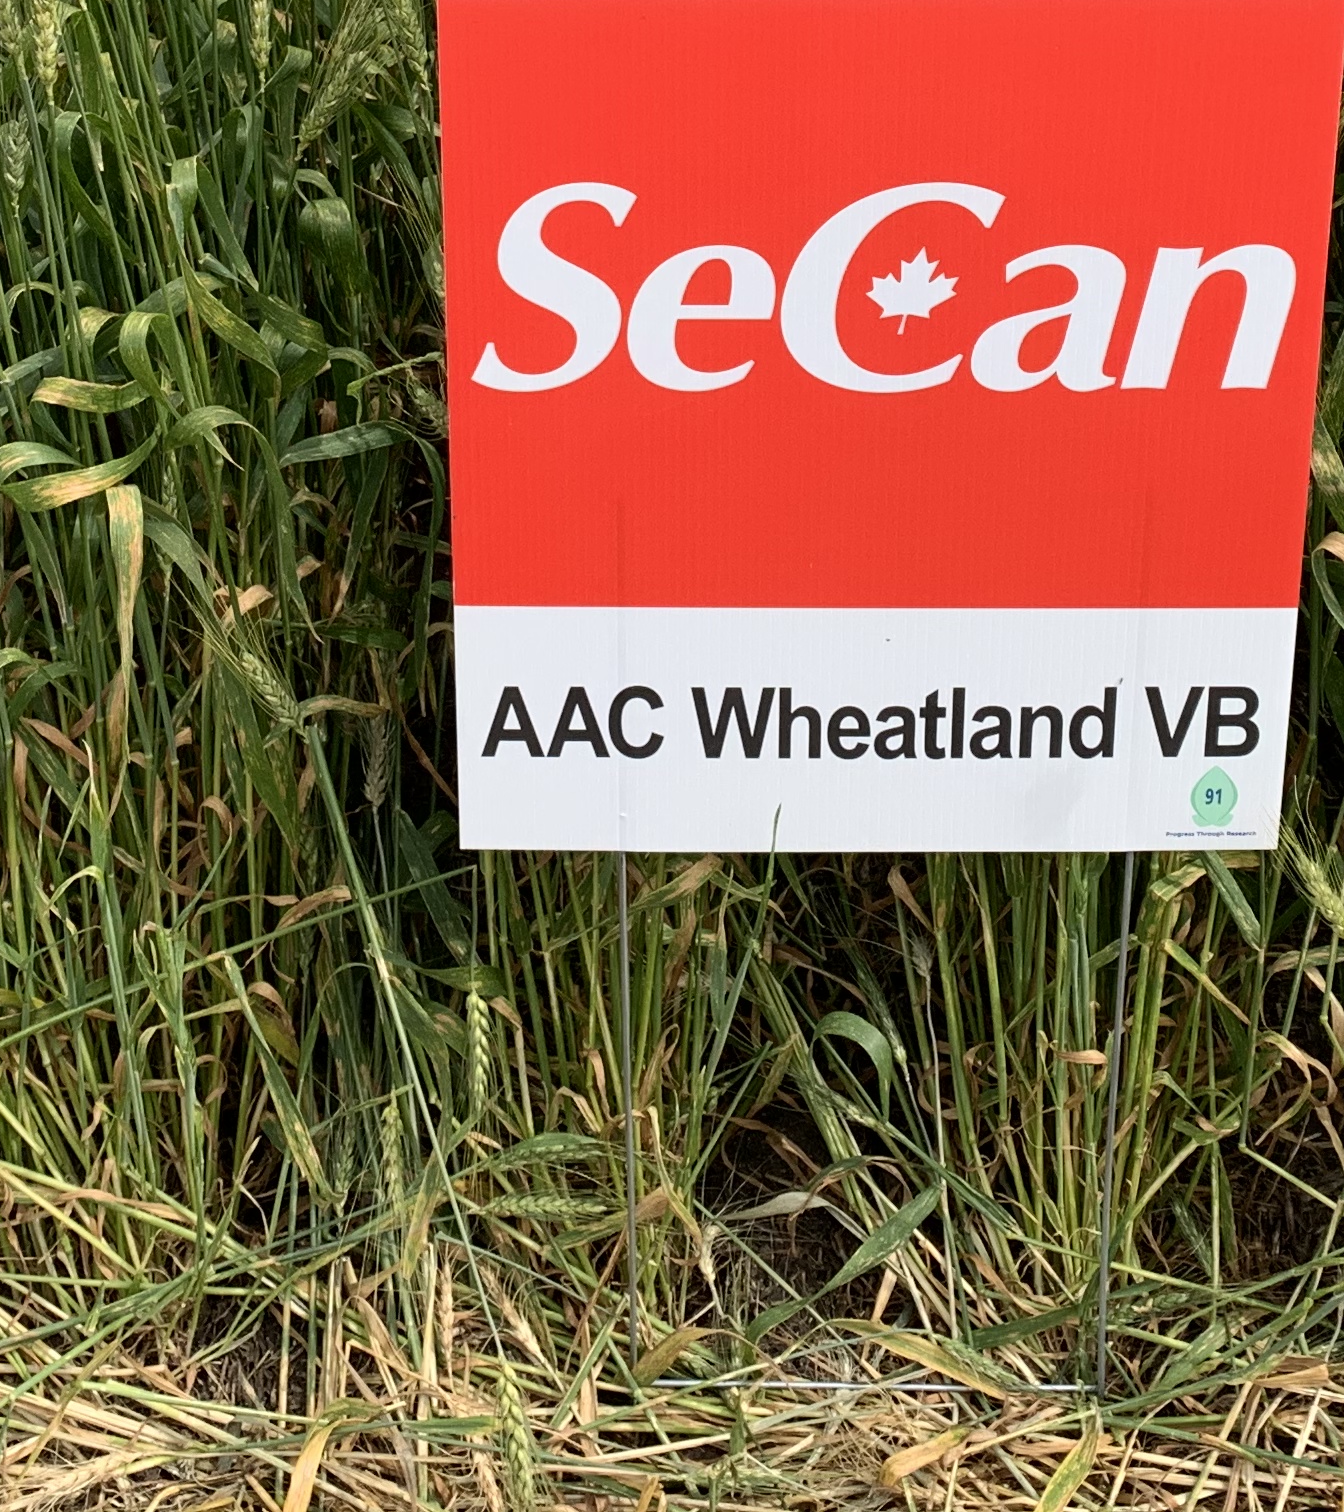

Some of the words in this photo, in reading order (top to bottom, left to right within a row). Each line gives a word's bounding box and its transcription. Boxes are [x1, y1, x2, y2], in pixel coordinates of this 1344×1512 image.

[471, 181, 1298, 394] SeCan
[481, 685, 665, 761] AAC
[692, 684, 1116, 761] Wheatland
[1146, 685, 1261, 758] VB
[1205, 788, 1223, 805] 91
